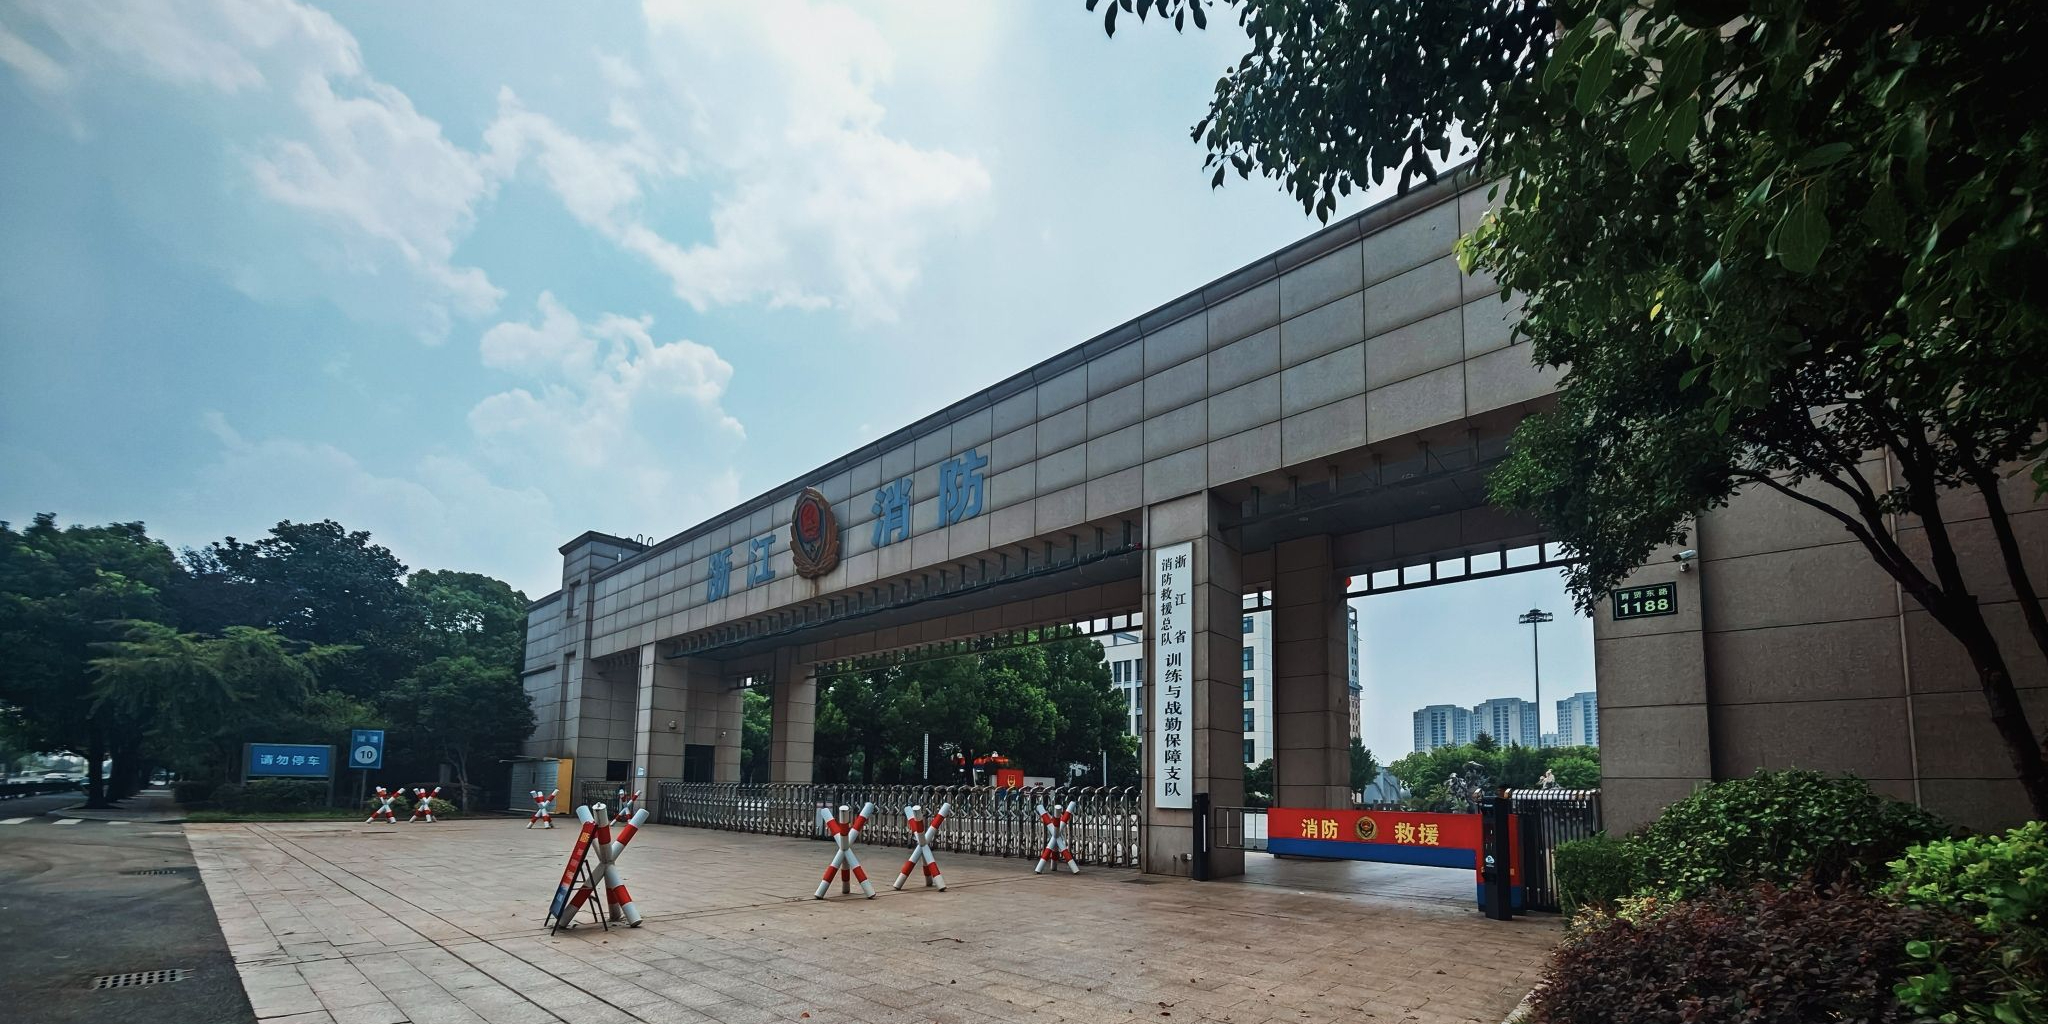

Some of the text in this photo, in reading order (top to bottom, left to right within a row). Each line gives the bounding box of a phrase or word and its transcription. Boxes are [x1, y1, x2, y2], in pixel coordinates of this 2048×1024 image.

[707, 448, 989, 603] 浙江 消防
[1160, 557, 1173, 647] 消防救援总队
[1174, 554, 1187, 645] 浙江省
[1620, 598, 1669, 615] 1188
[1164, 652, 1183, 797] 训练与战勤保障支队
[260, 754, 320, 766] 请勿停车
[360, 750, 373, 759] 10
[1301, 818, 1440, 846] 消防 救援
